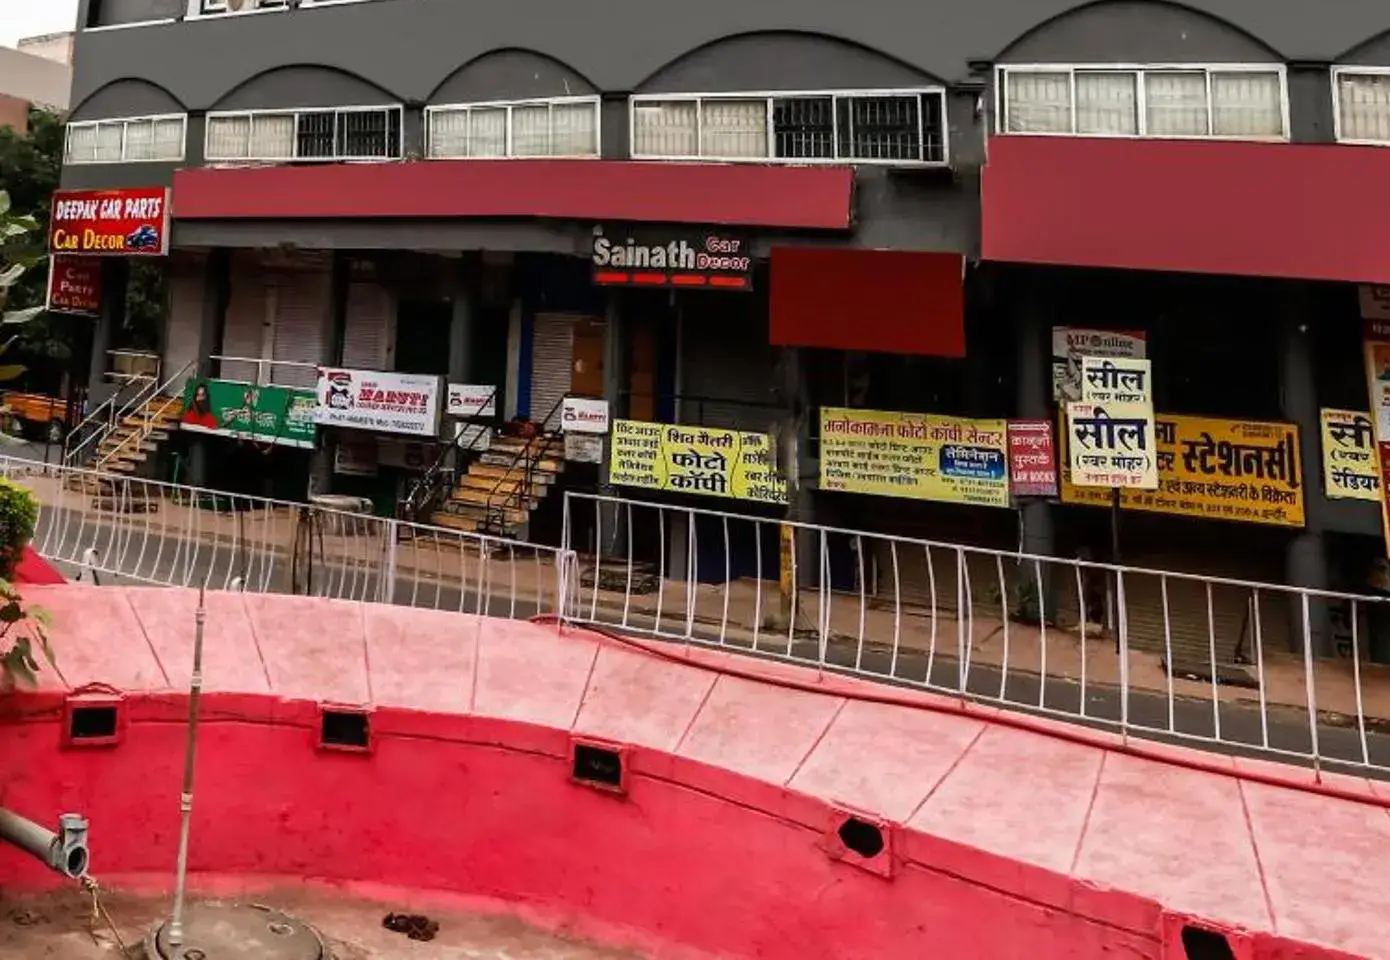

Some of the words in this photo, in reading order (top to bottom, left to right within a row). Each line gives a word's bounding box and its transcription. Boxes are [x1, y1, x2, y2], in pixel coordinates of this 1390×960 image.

[56, 198, 99, 221] DEEPAK
[100, 198, 123, 221] CAR
[124, 197, 162, 220] PARTS
[593, 237, 695, 270] Sainath
[706, 235, 741, 253] Car
[696, 253, 750, 271] Decor
[1085, 360, 1146, 391] सील
[1073, 406, 1148, 451] सील
[671, 449, 727, 472] फोटो
[669, 470, 727, 493] कॉपी
